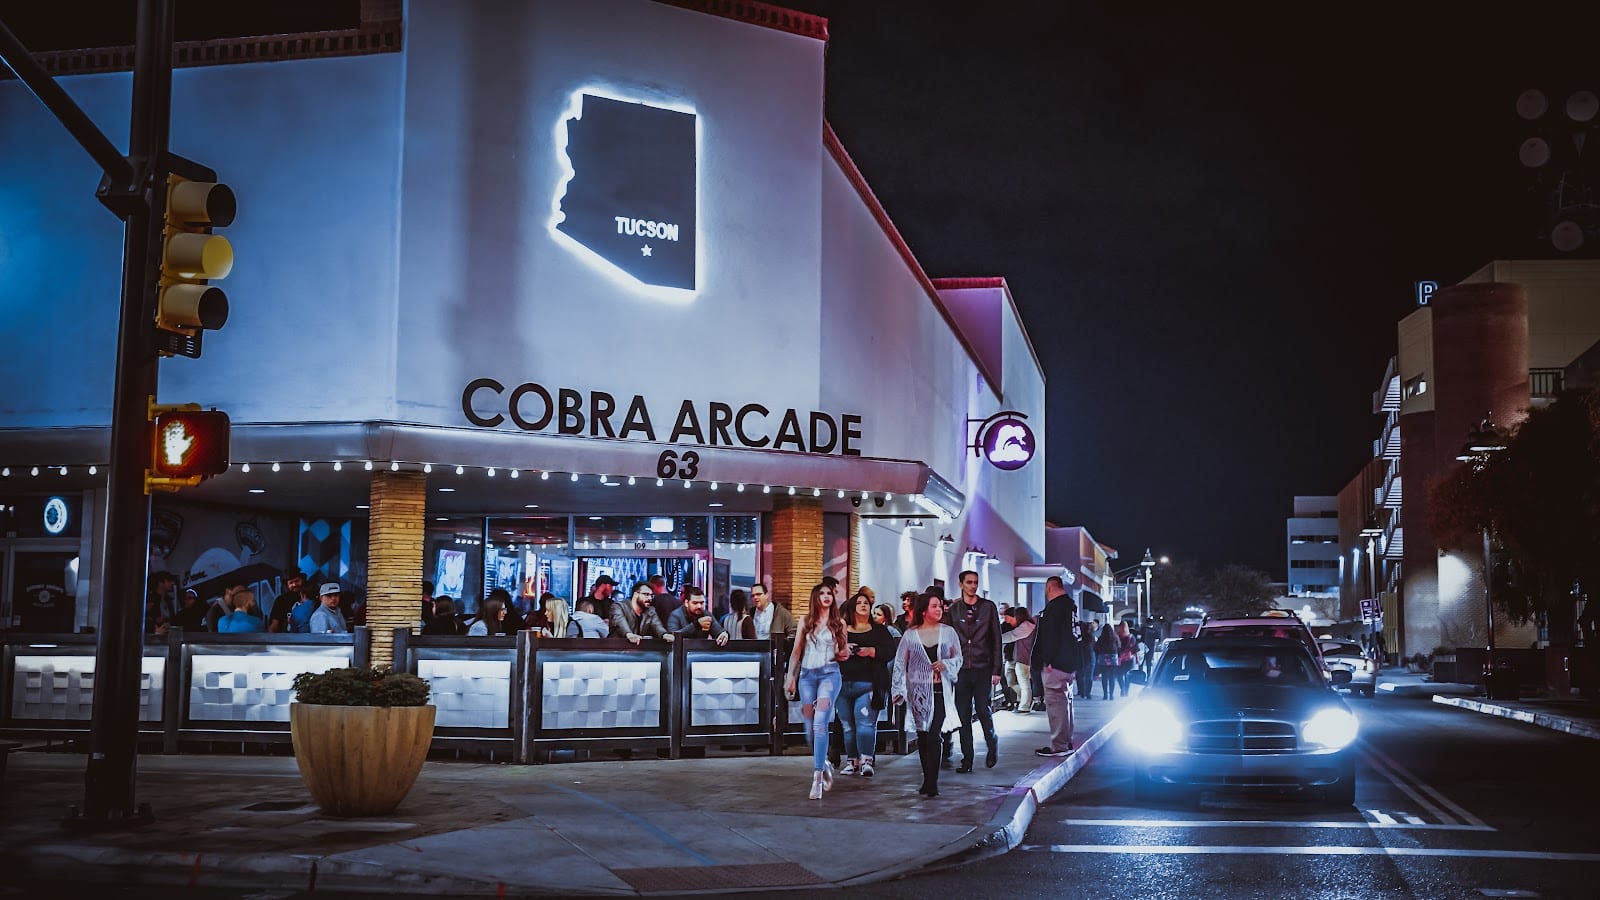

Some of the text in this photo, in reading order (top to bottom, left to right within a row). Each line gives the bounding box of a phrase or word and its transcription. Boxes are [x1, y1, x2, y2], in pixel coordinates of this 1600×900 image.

[615, 217, 679, 241] TUCSON
[1418, 280, 1439, 305] P
[462, 378, 862, 456] COBRA ARCADE
[657, 450, 700, 479] 63
[634, 542, 645, 550] 109
